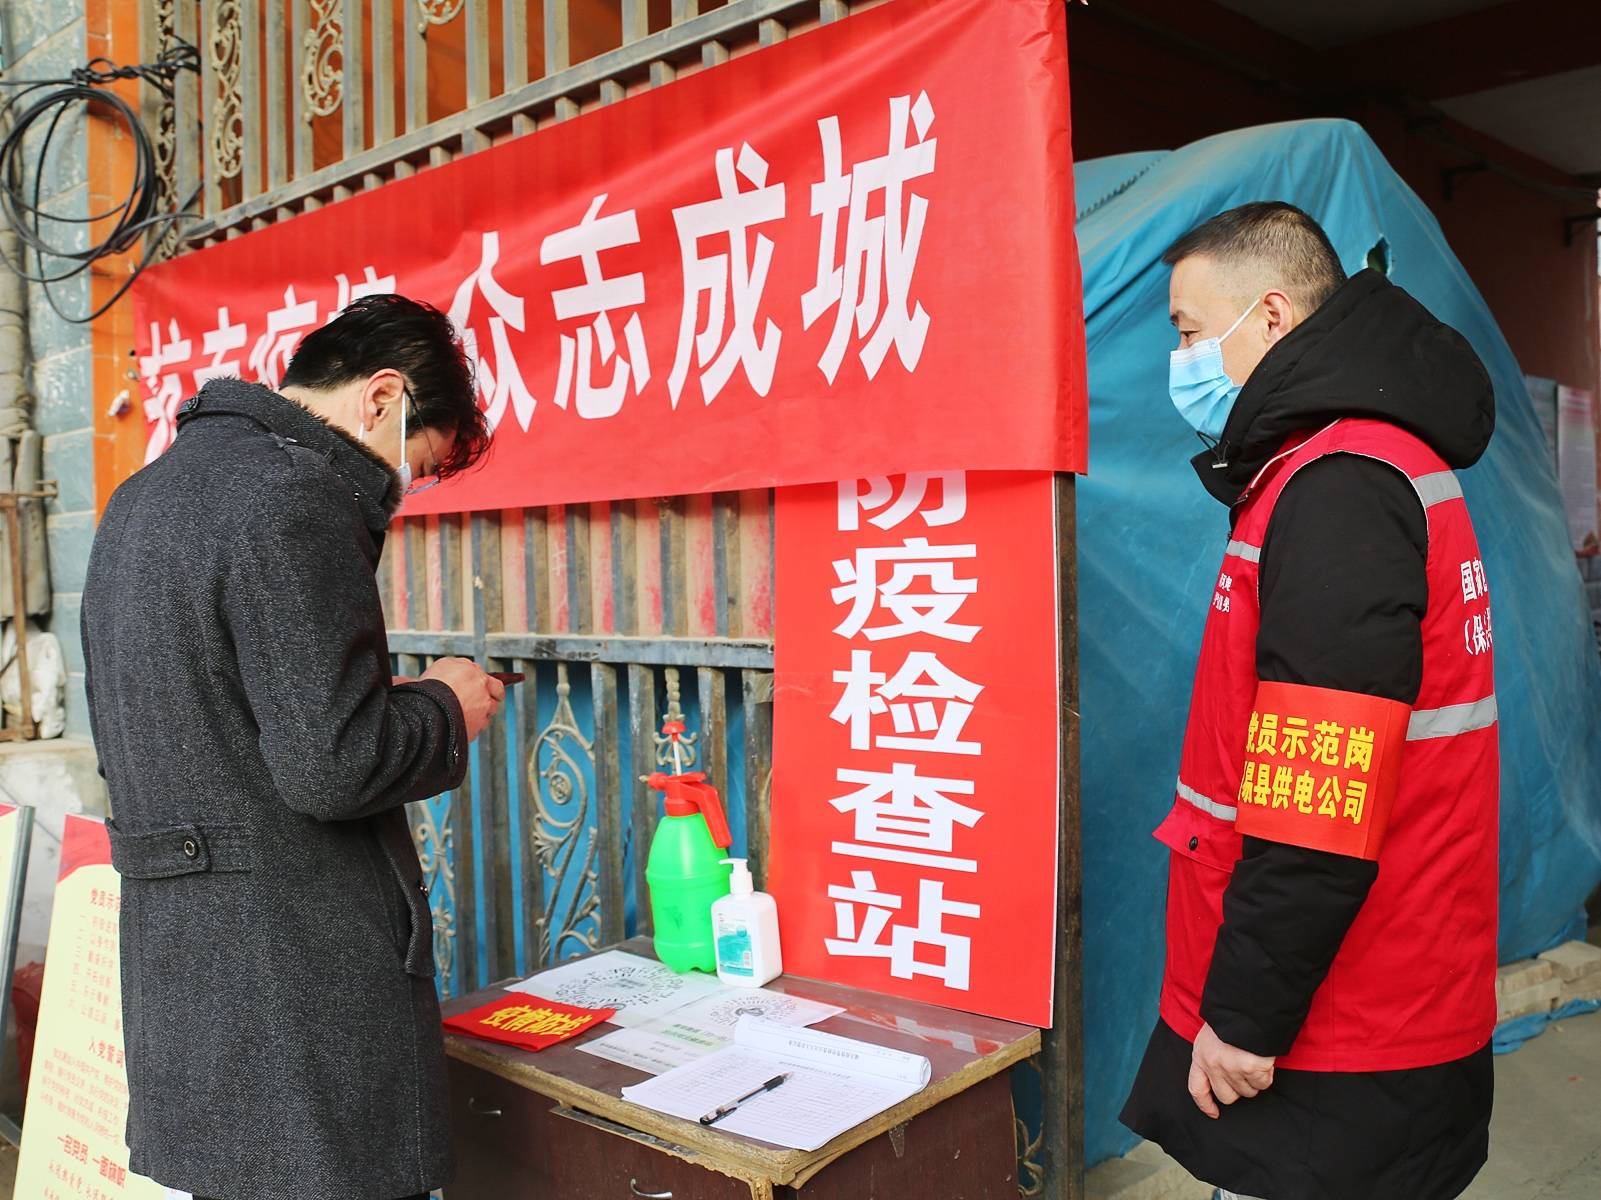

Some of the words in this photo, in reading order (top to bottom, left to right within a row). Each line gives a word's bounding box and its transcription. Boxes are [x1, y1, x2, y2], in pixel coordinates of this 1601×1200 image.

[445, 89, 937, 434] 众志成城
[824, 470, 985, 991] 防疫检查站
[1238, 760, 1367, 825] 易县供电公司
[1246, 711, 1375, 773] 党员示范岗
